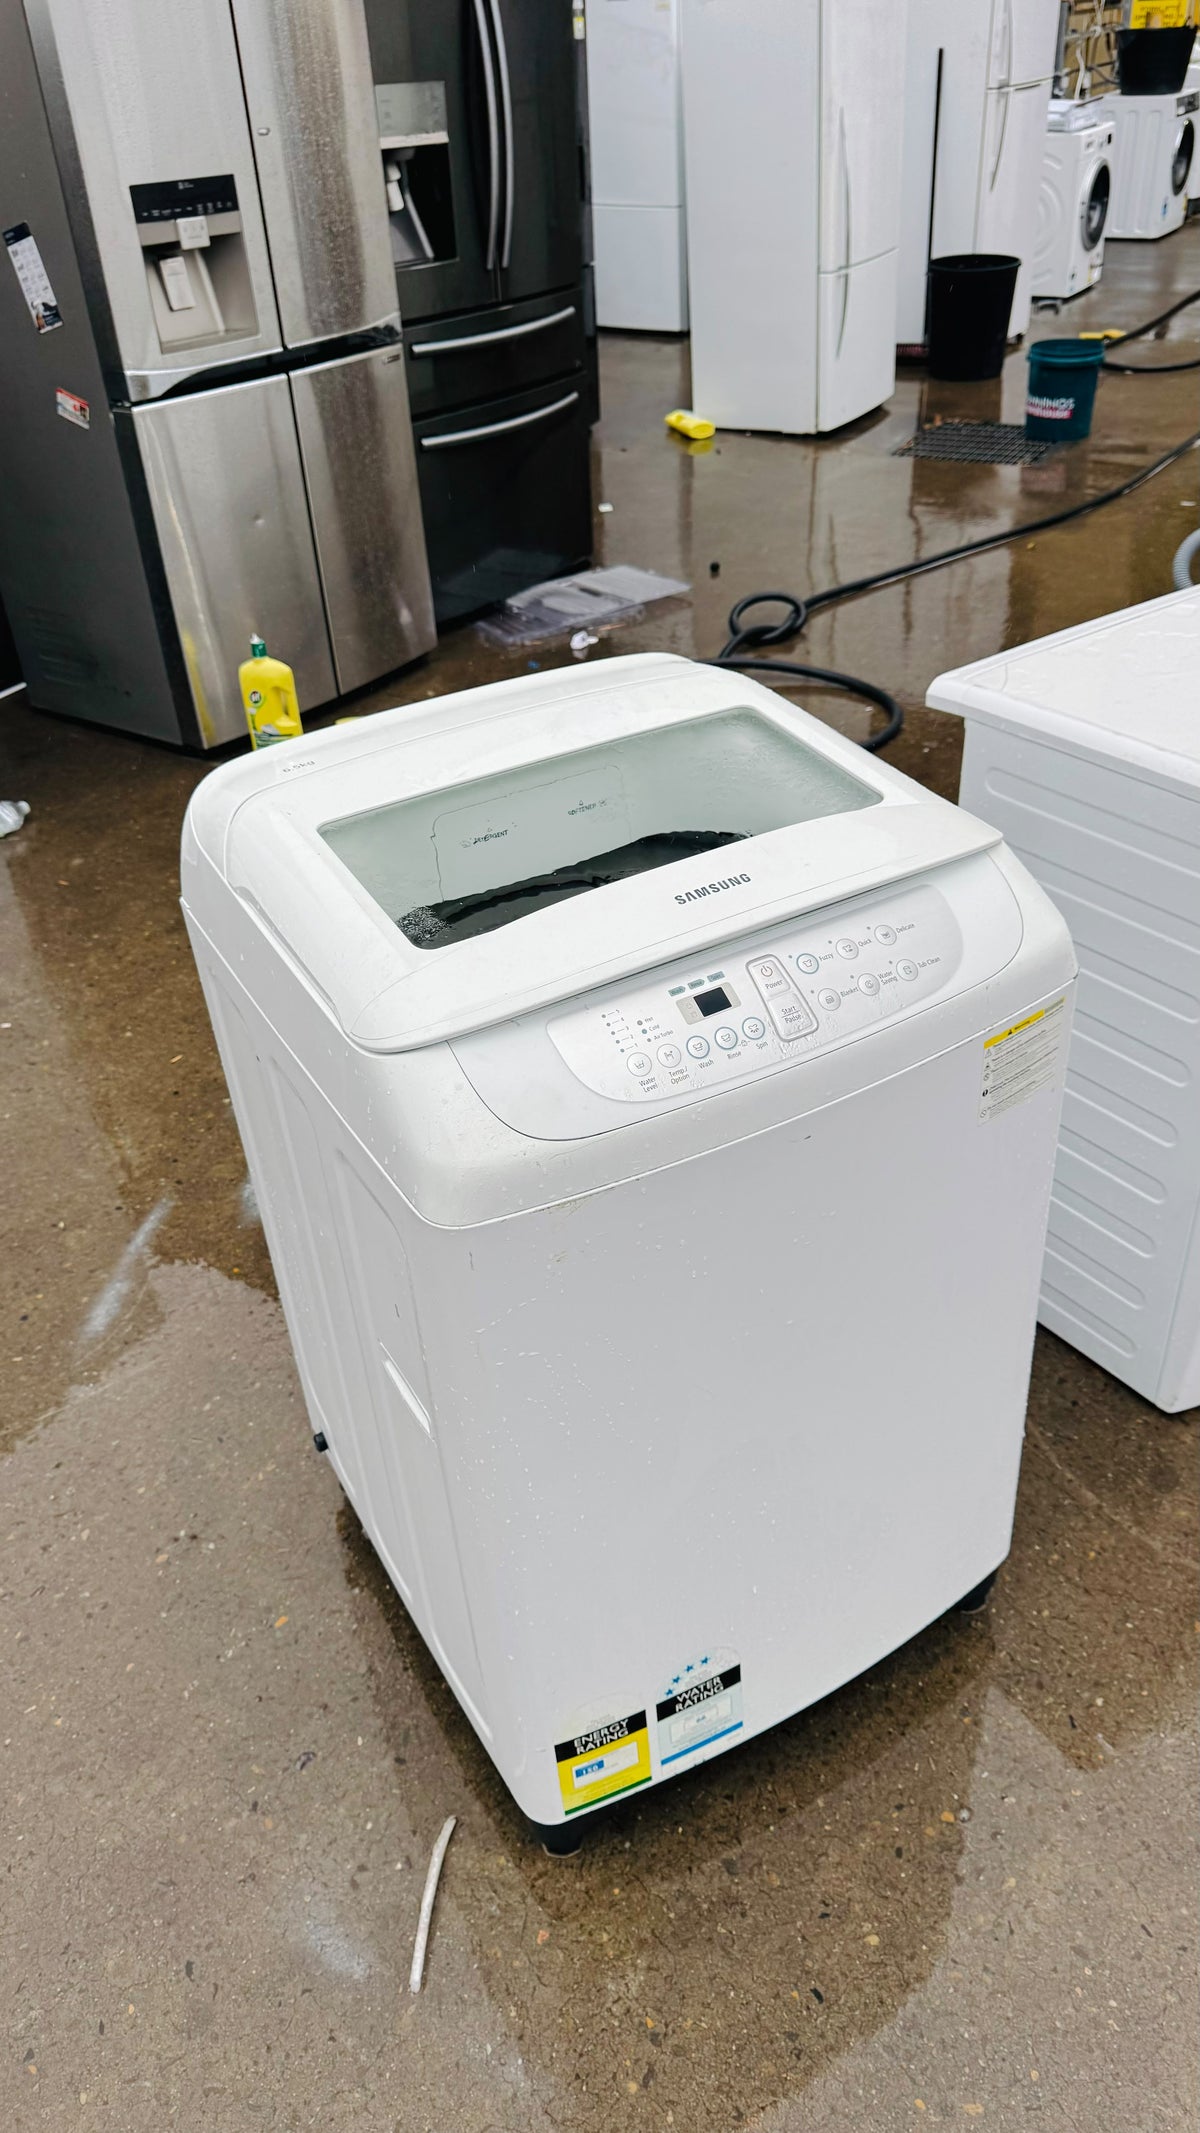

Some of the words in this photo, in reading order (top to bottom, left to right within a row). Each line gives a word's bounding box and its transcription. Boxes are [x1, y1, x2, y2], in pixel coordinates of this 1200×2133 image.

[674, 873, 752, 905] SAMSUNG
[896, 923, 915, 934] Delicate
[857, 938, 872, 948] Quick
[818, 952, 834, 962] Fuzzy
[878, 970, 893, 979] Water
[765, 979, 783, 990] Power
[881, 975, 898, 986] Saving
[840, 986, 859, 998] Blanket
[781, 1005, 797, 1016] Start
[785, 1014, 802, 1024] Pause
[755, 1040, 769, 1050] Spin
[727, 1051, 742, 1060] Rinse
[698, 1059, 714, 1070] Wash
[638, 1076, 657, 1087] Water
[670, 1073, 690, 1085] Option
[643, 1082, 659, 1093] Level
[676, 1676, 721, 1702] WATER
[675, 1684, 724, 1713] RATING
[574, 1718, 629, 1748] ENERGY
[576, 1727, 629, 1755] RATING
